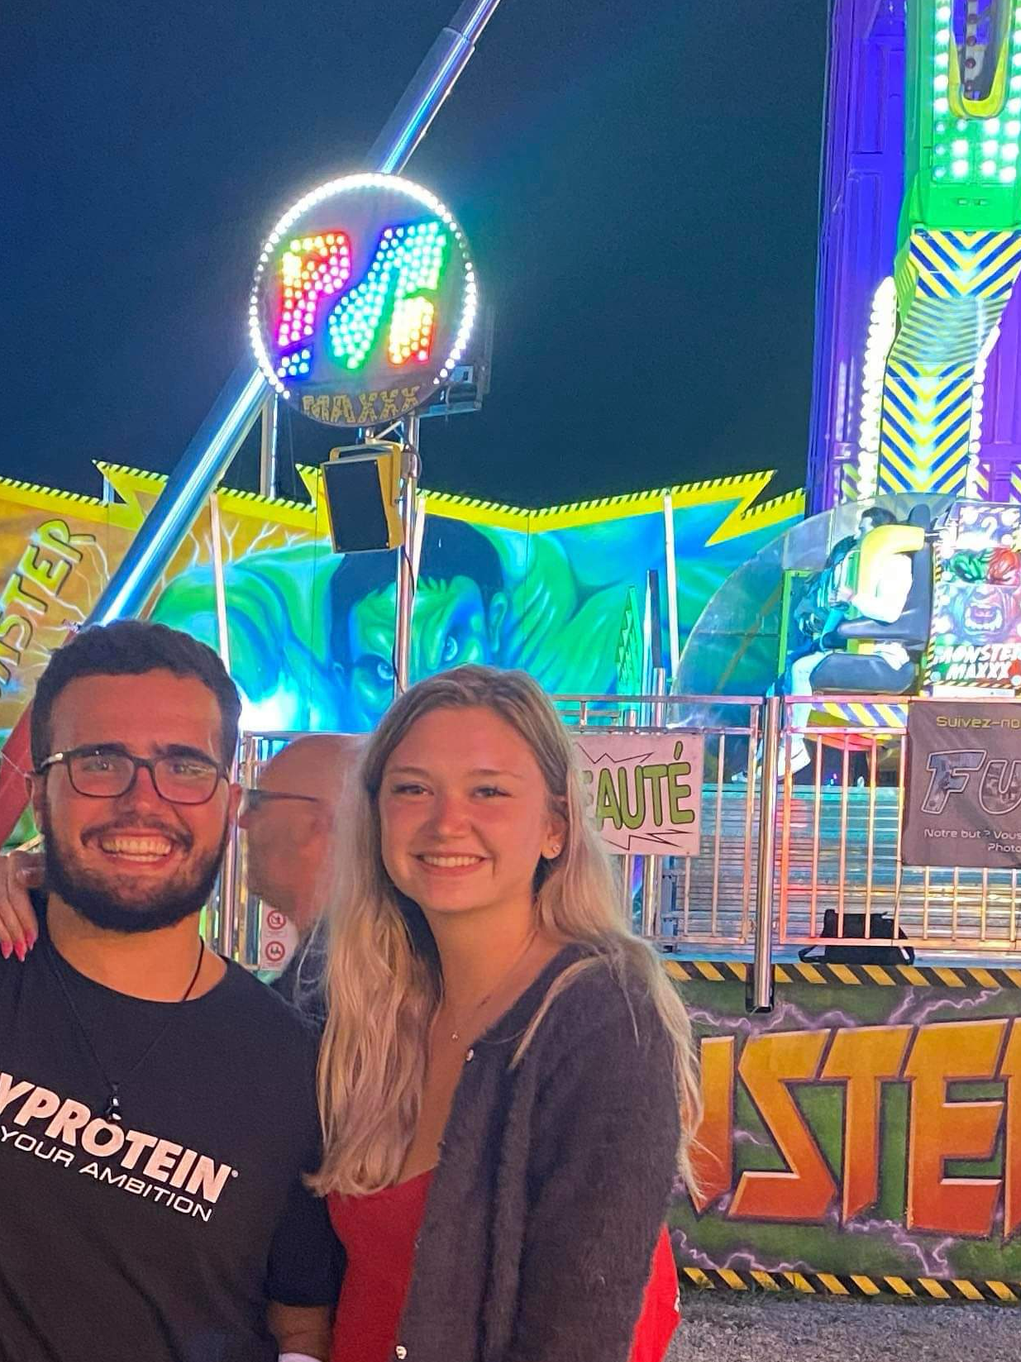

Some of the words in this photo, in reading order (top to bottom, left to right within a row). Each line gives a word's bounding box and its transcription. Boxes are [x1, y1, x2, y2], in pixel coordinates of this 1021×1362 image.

[302, 385, 421, 424] MAXXX
[924, 828, 958, 838] Notre
[961, 829, 981, 839] but
[0, 1125, 75, 1168] YOUR
[79, 1161, 213, 1222] AMBITION
